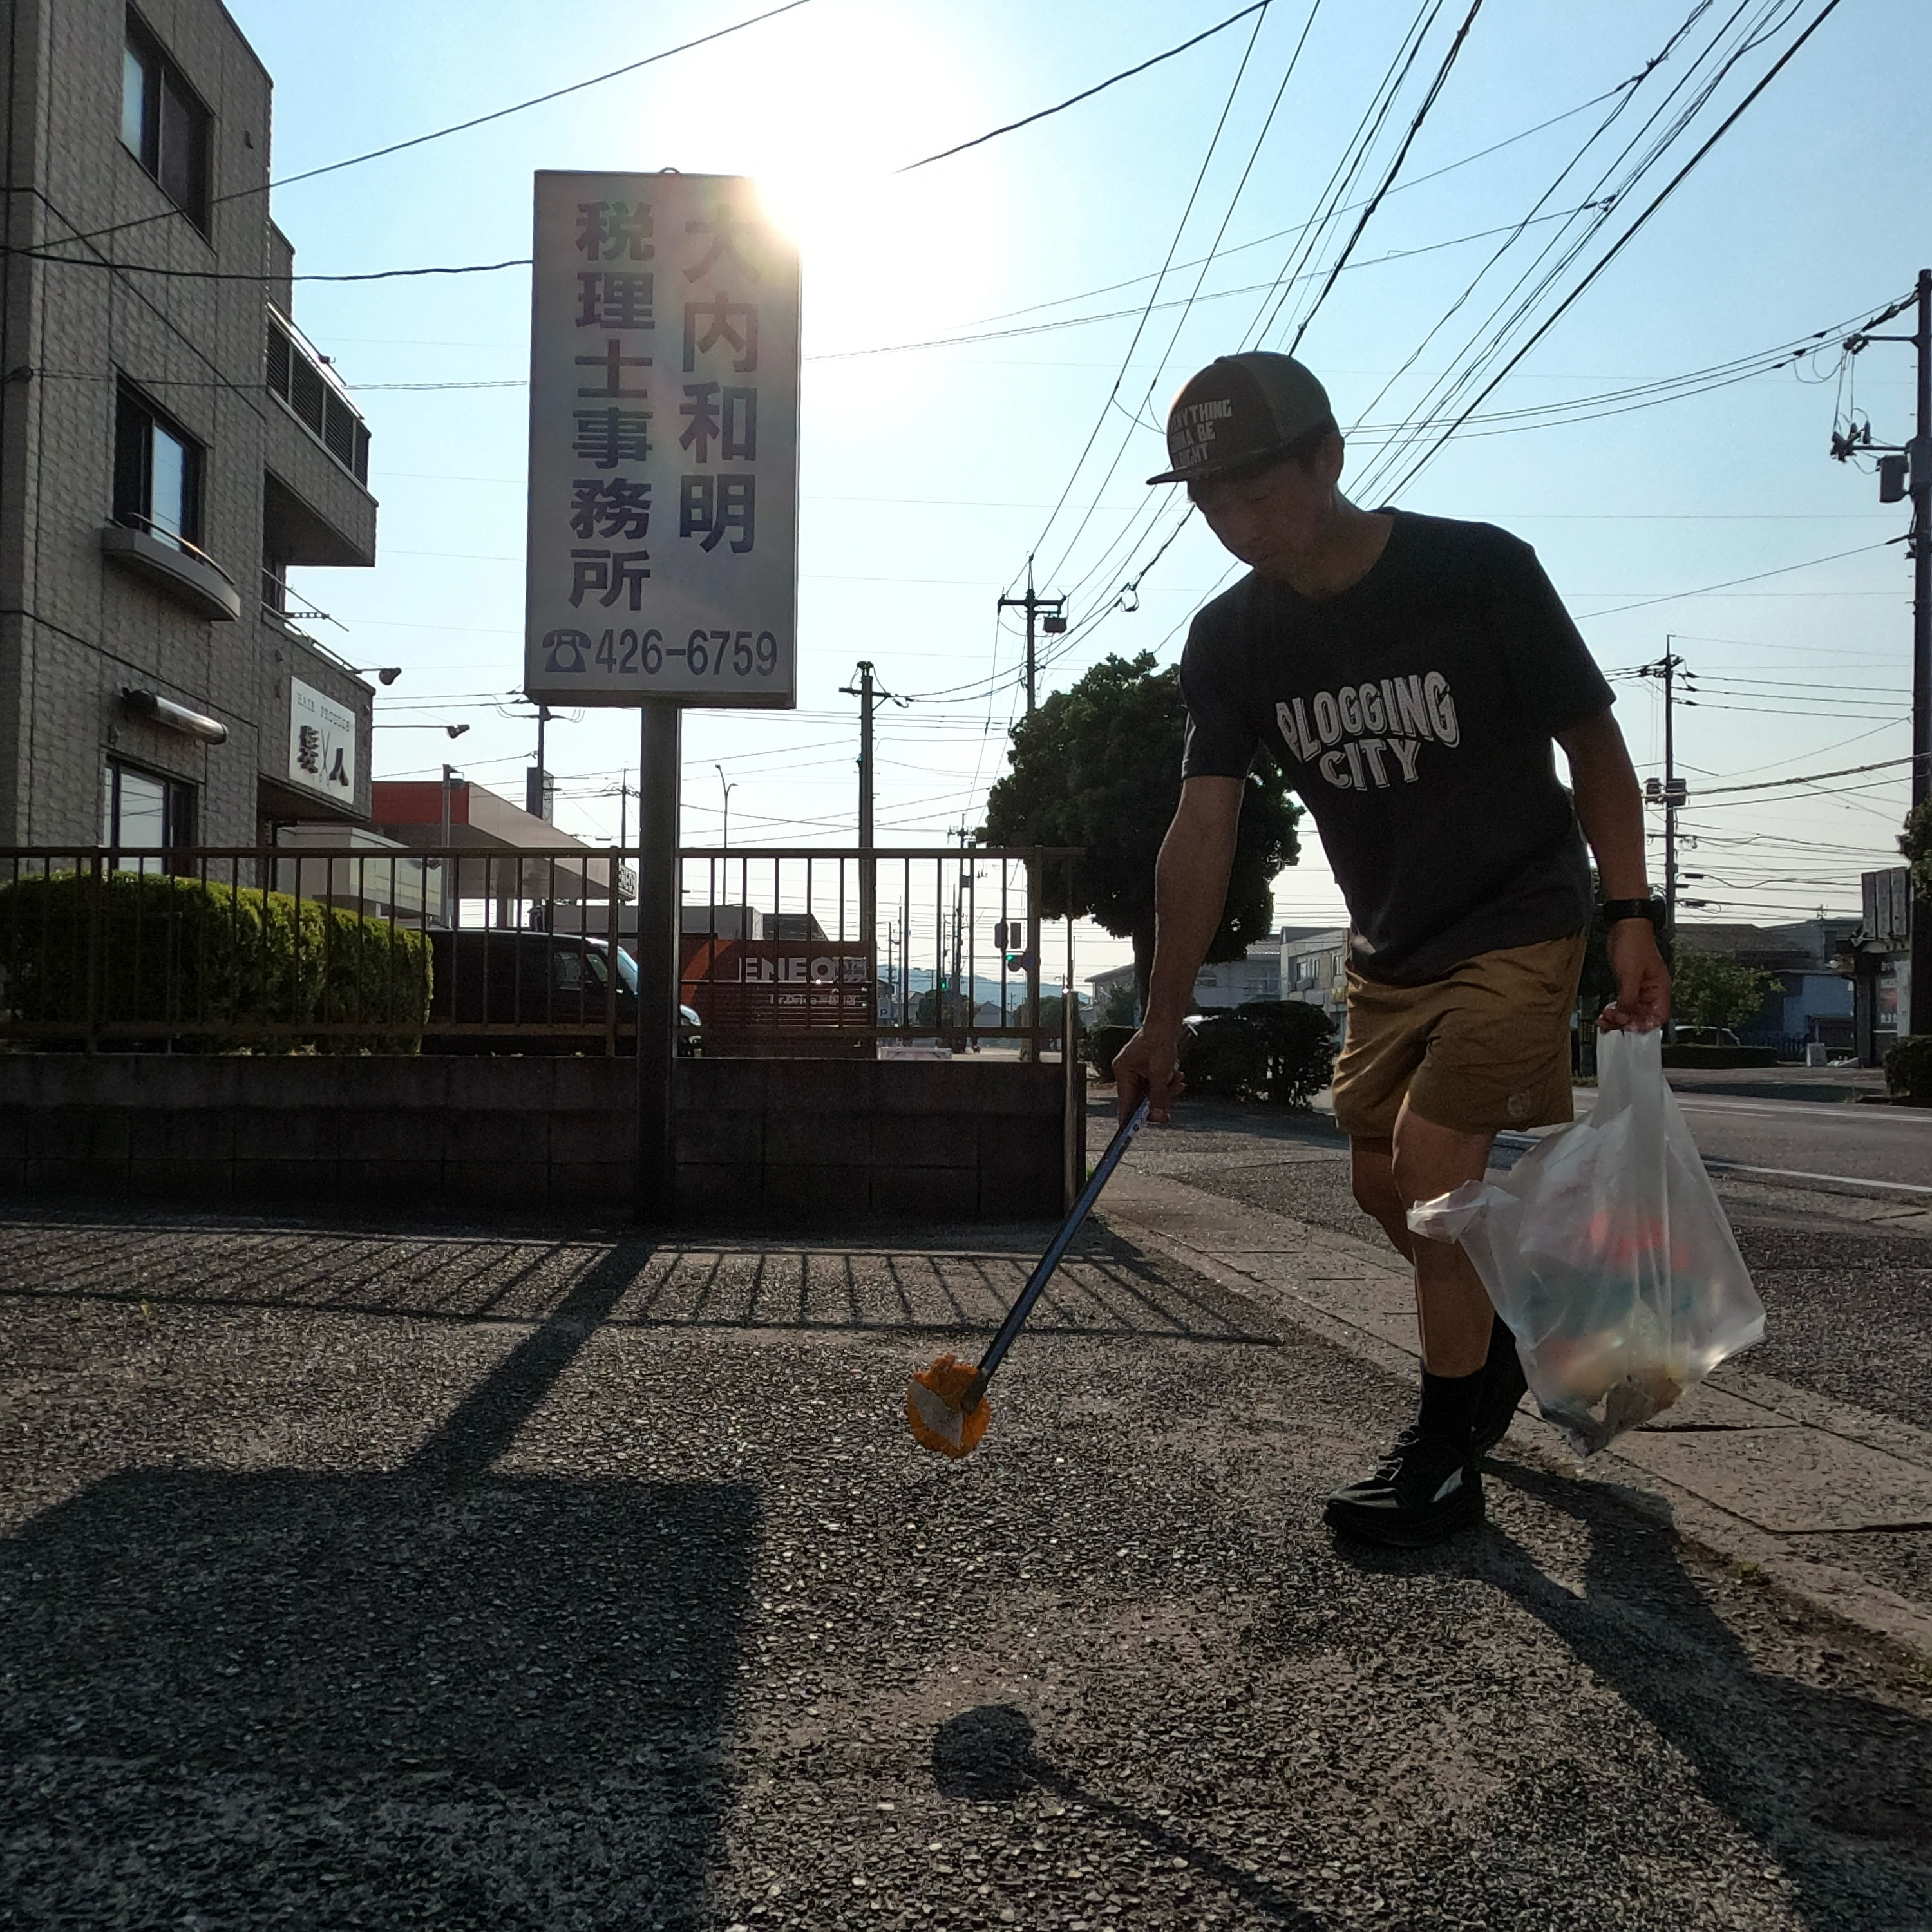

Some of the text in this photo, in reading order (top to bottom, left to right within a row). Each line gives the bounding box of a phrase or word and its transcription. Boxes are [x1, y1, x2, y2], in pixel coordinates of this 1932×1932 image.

[568, 201, 655, 611] 税理士事務所
[679, 204, 761, 554] 大内和明
[595, 627, 778, 677] 426-6759
[1320, 738, 1421, 791] CITY
